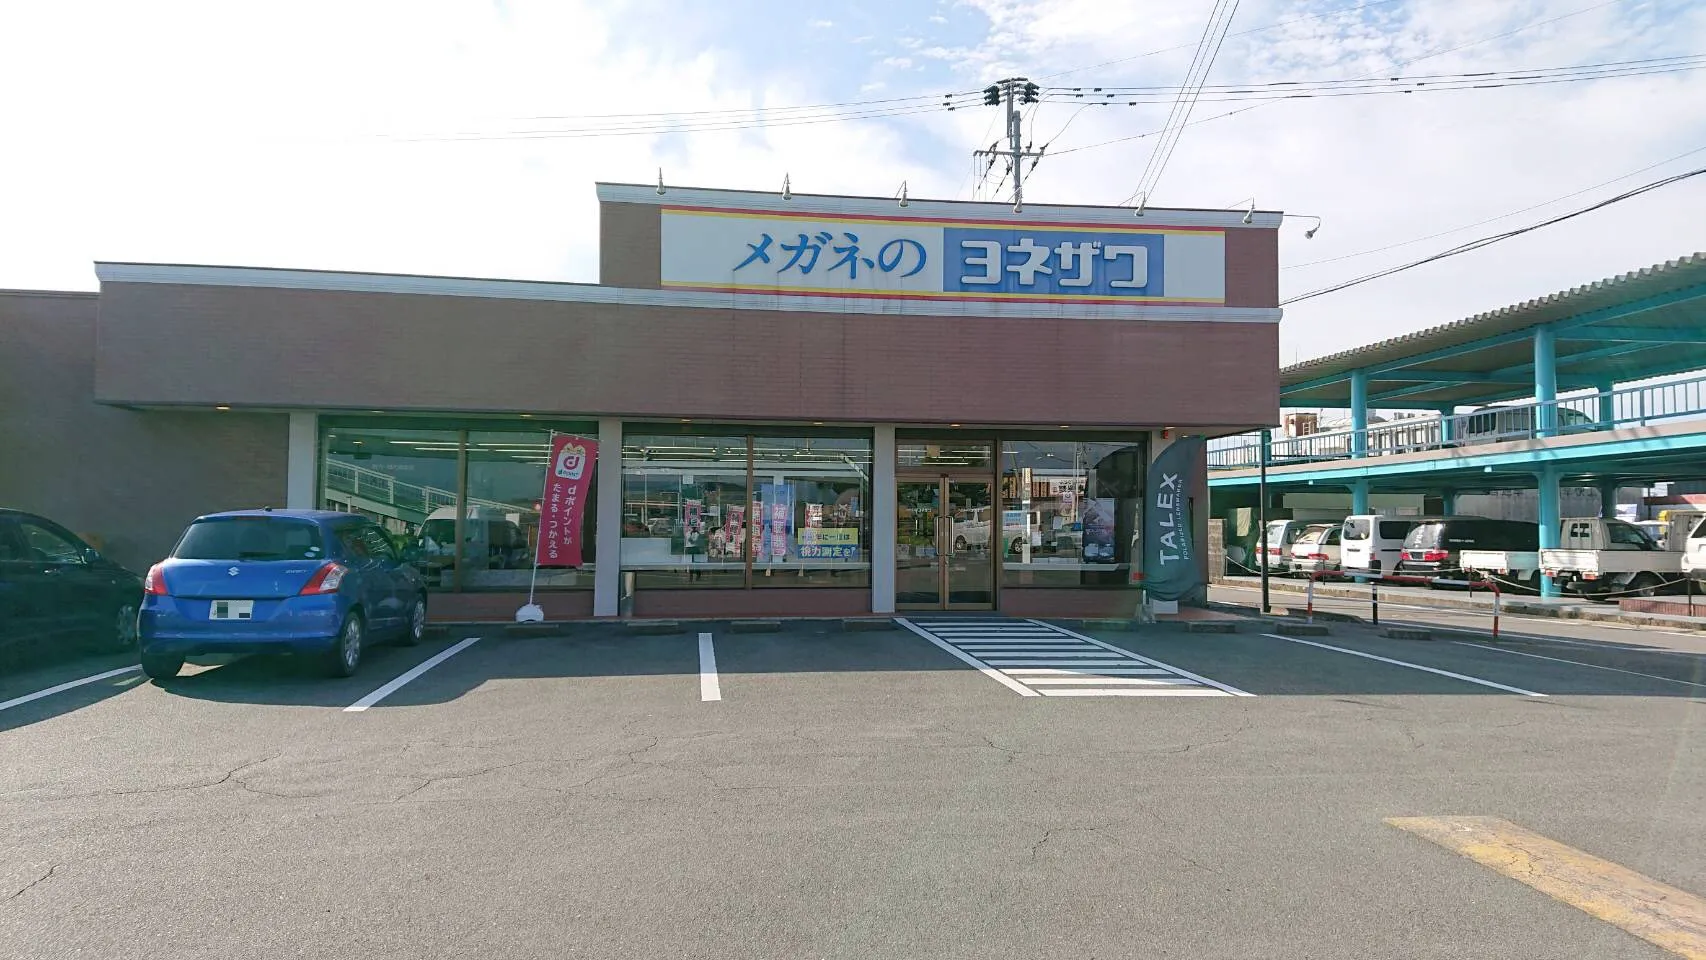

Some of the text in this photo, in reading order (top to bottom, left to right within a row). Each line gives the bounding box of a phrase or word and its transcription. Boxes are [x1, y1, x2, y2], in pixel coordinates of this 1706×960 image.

[732, 232, 1148, 289] メガネの ヨネザワ
[564, 485, 577, 544] dポイントが
[1157, 473, 1180, 565] TALEX
